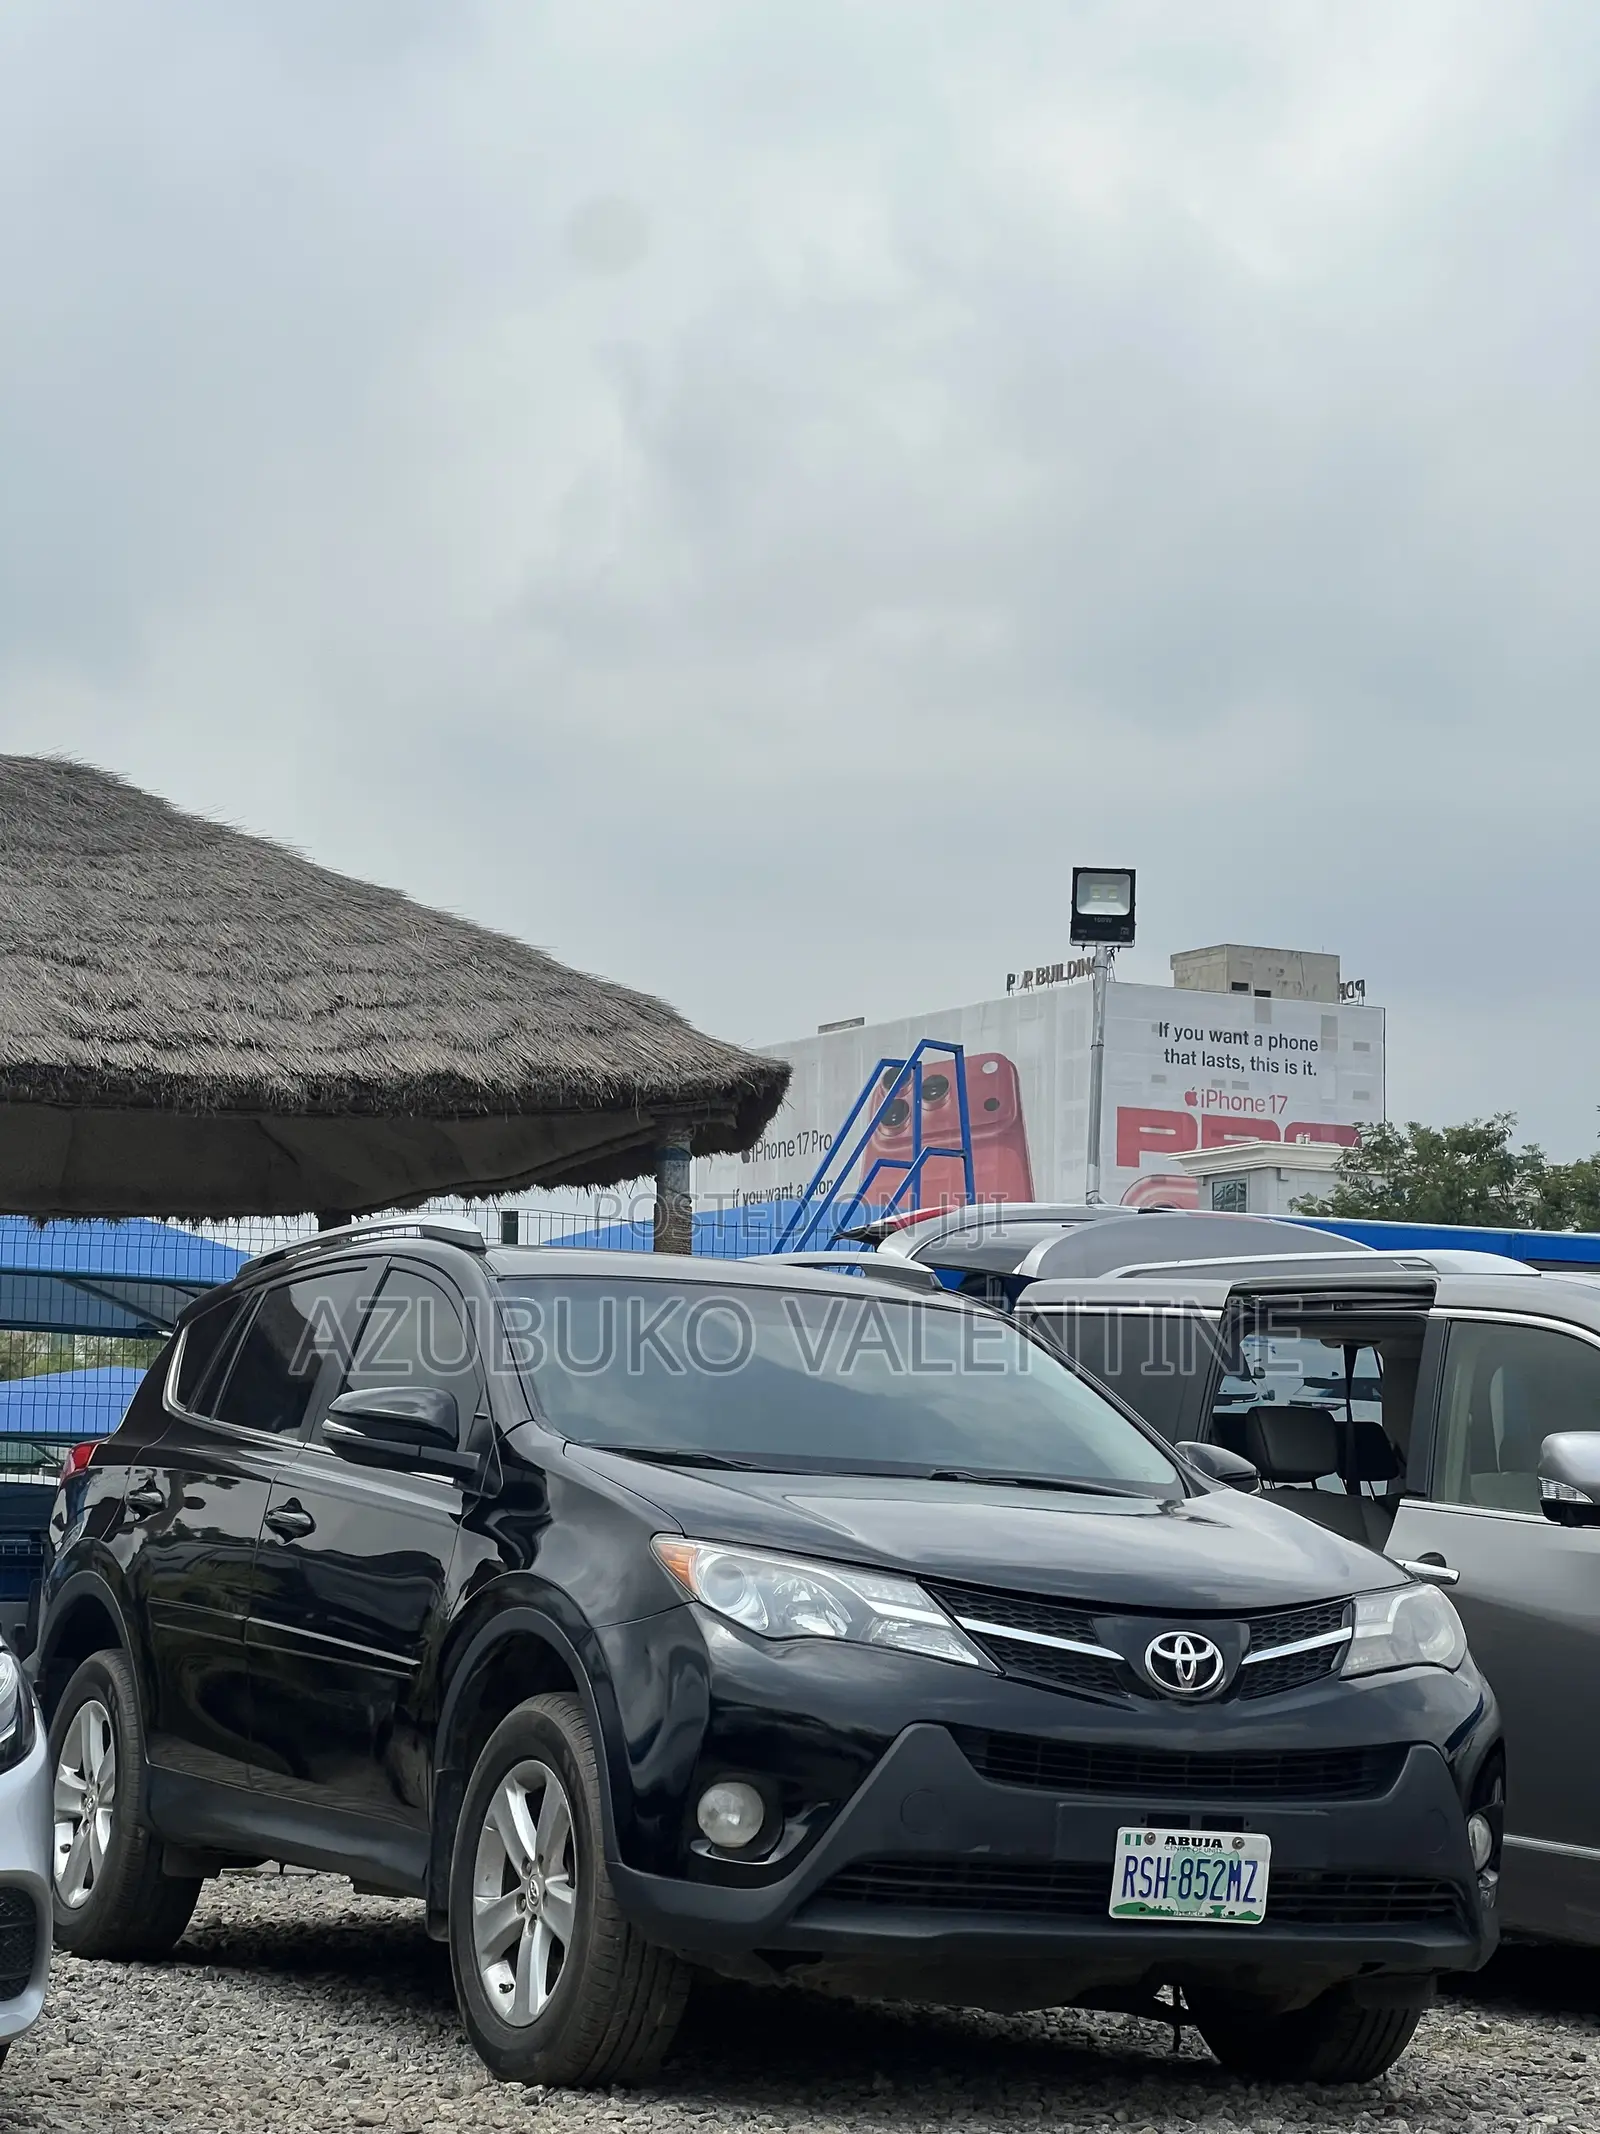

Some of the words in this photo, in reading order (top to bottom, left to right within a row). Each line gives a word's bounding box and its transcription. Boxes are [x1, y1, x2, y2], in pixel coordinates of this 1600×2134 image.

[1158, 1021, 1170, 1038] If
[1174, 1027, 1204, 1043] you
[1209, 1029, 1249, 1046] want
[1253, 1034, 1263, 1047] a
[1268, 1033, 1319, 1052] phone
[1164, 1048, 1197, 1066] that
[1201, 1051, 1245, 1073] lasts,
[1250, 1056, 1279, 1073] this
[1284, 1058, 1298, 1075] is
[1303, 1060, 1317, 1076] it.
[1200, 1088, 1266, 1112] iPhone
[1269, 1094, 1288, 1115] 17
[752, 1138, 795, 1163] iPhone
[796, 1131, 810, 1156] 17
[811, 1130, 833, 1154] Pro
[742, 1190, 763, 1207] you
[766, 1182, 794, 1202] want
[796, 1183, 803, 1199] a
[1164, 1835, 1223, 1849] ABUJA
[1121, 1855, 1258, 1904] RSH-852MZ
